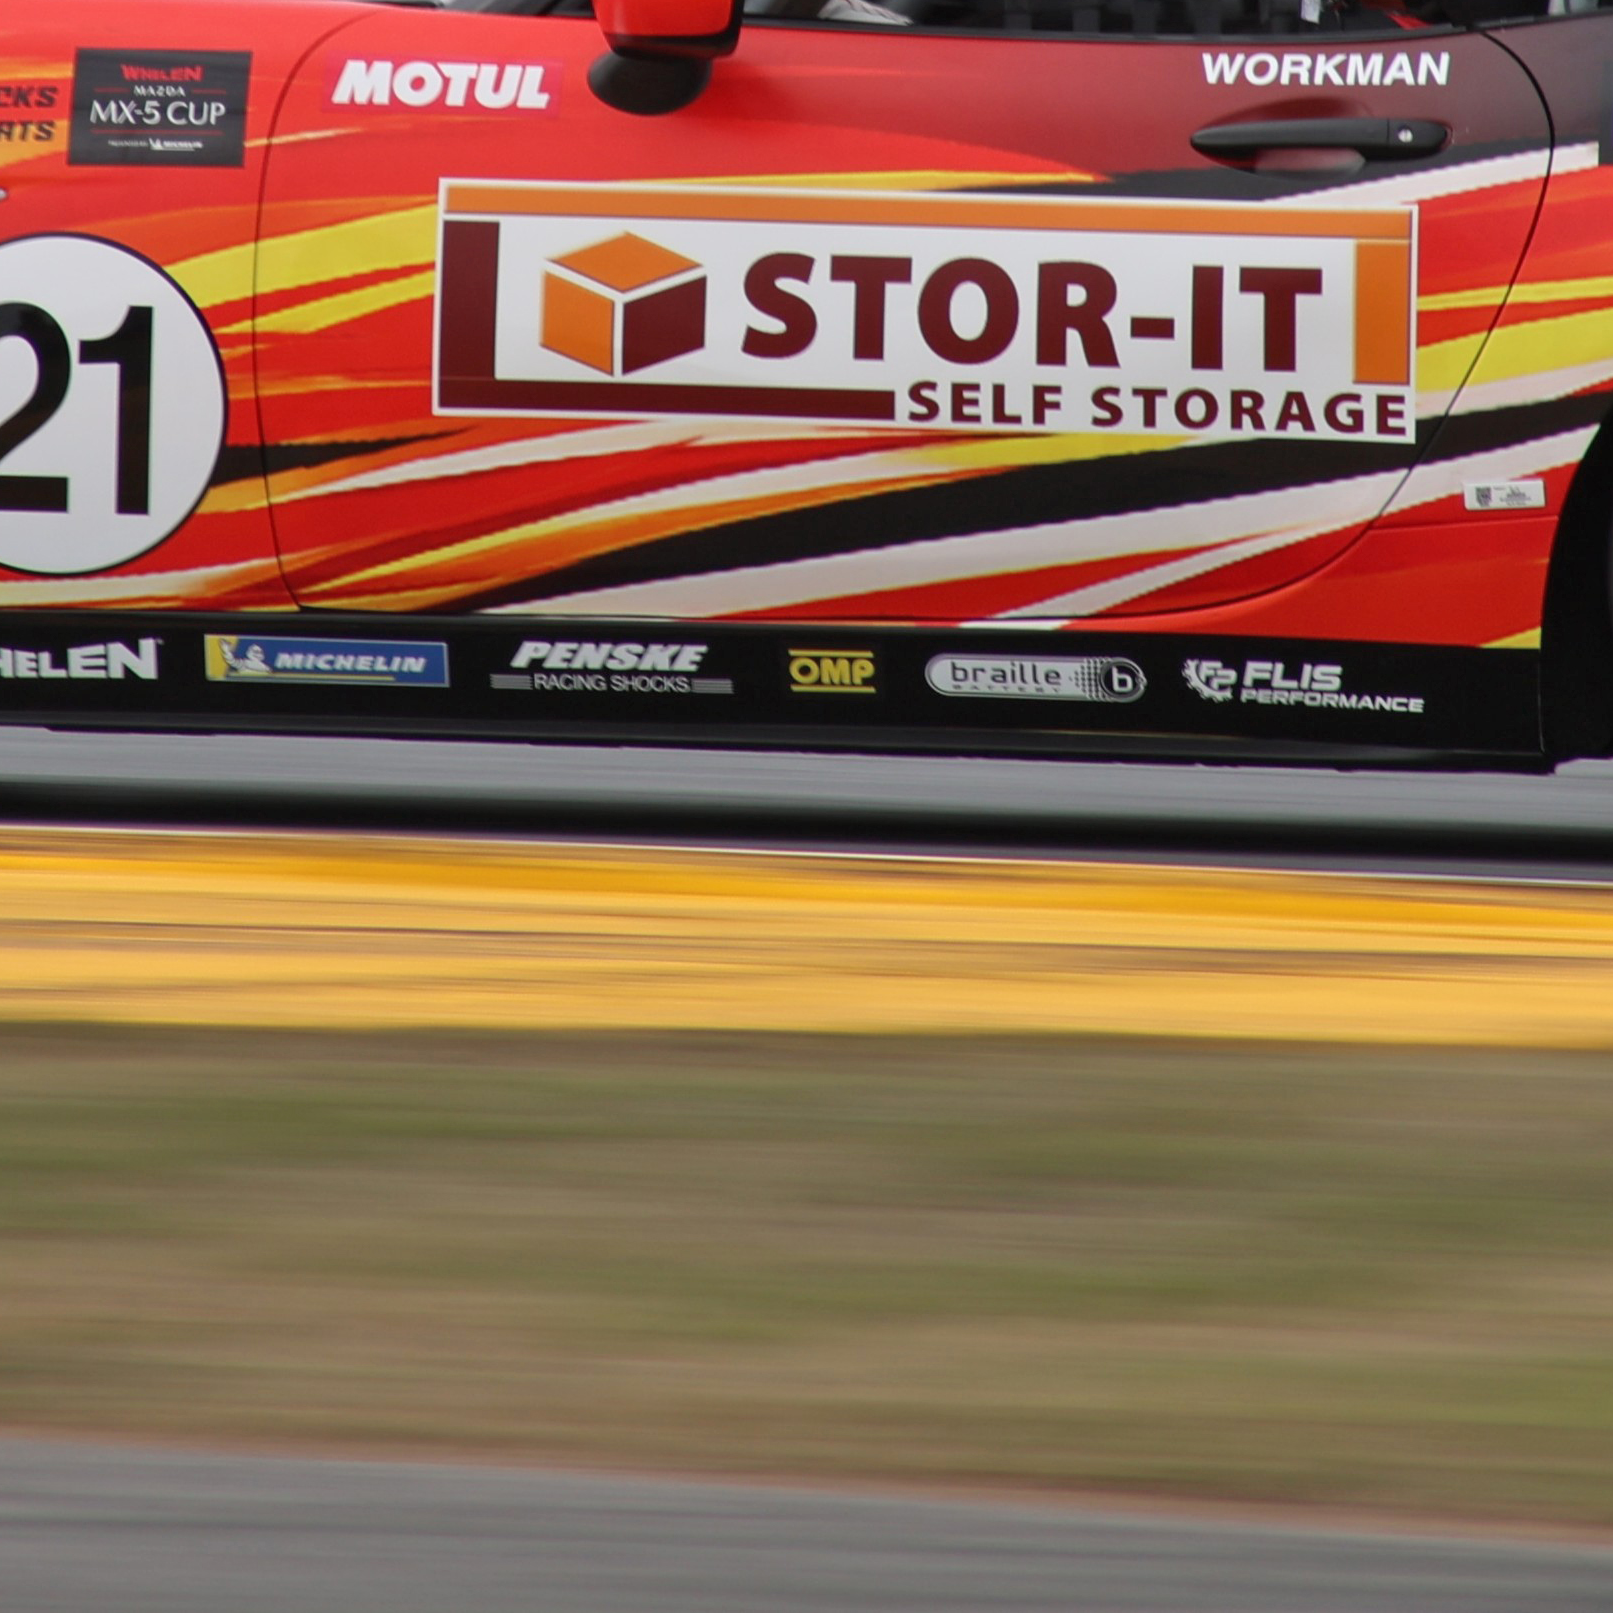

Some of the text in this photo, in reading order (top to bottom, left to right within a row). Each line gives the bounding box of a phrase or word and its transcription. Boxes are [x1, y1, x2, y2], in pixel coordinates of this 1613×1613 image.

[121, 63, 204, 82] WHELEN
[1202, 52, 1451, 87] WORKMAN
[133, 85, 186, 97] MAZDA
[331, 59, 551, 110] MOTUL
[90, 99, 226, 126] MX-5 CUP
[741, 252, 1323, 373] STOR-IT
[908, 381, 1409, 437] SELF STORAGE
[274, 652, 427, 673] MICHELIN
[510, 640, 709, 672] PENSKE
[534, 673, 691, 693] RACING SHOCKS
[789, 657, 875, 686] OMP
[950, 661, 1062, 686] braille
[1242, 660, 1343, 691] FLIS
[1241, 687, 1425, 713] PERFORMANCE
